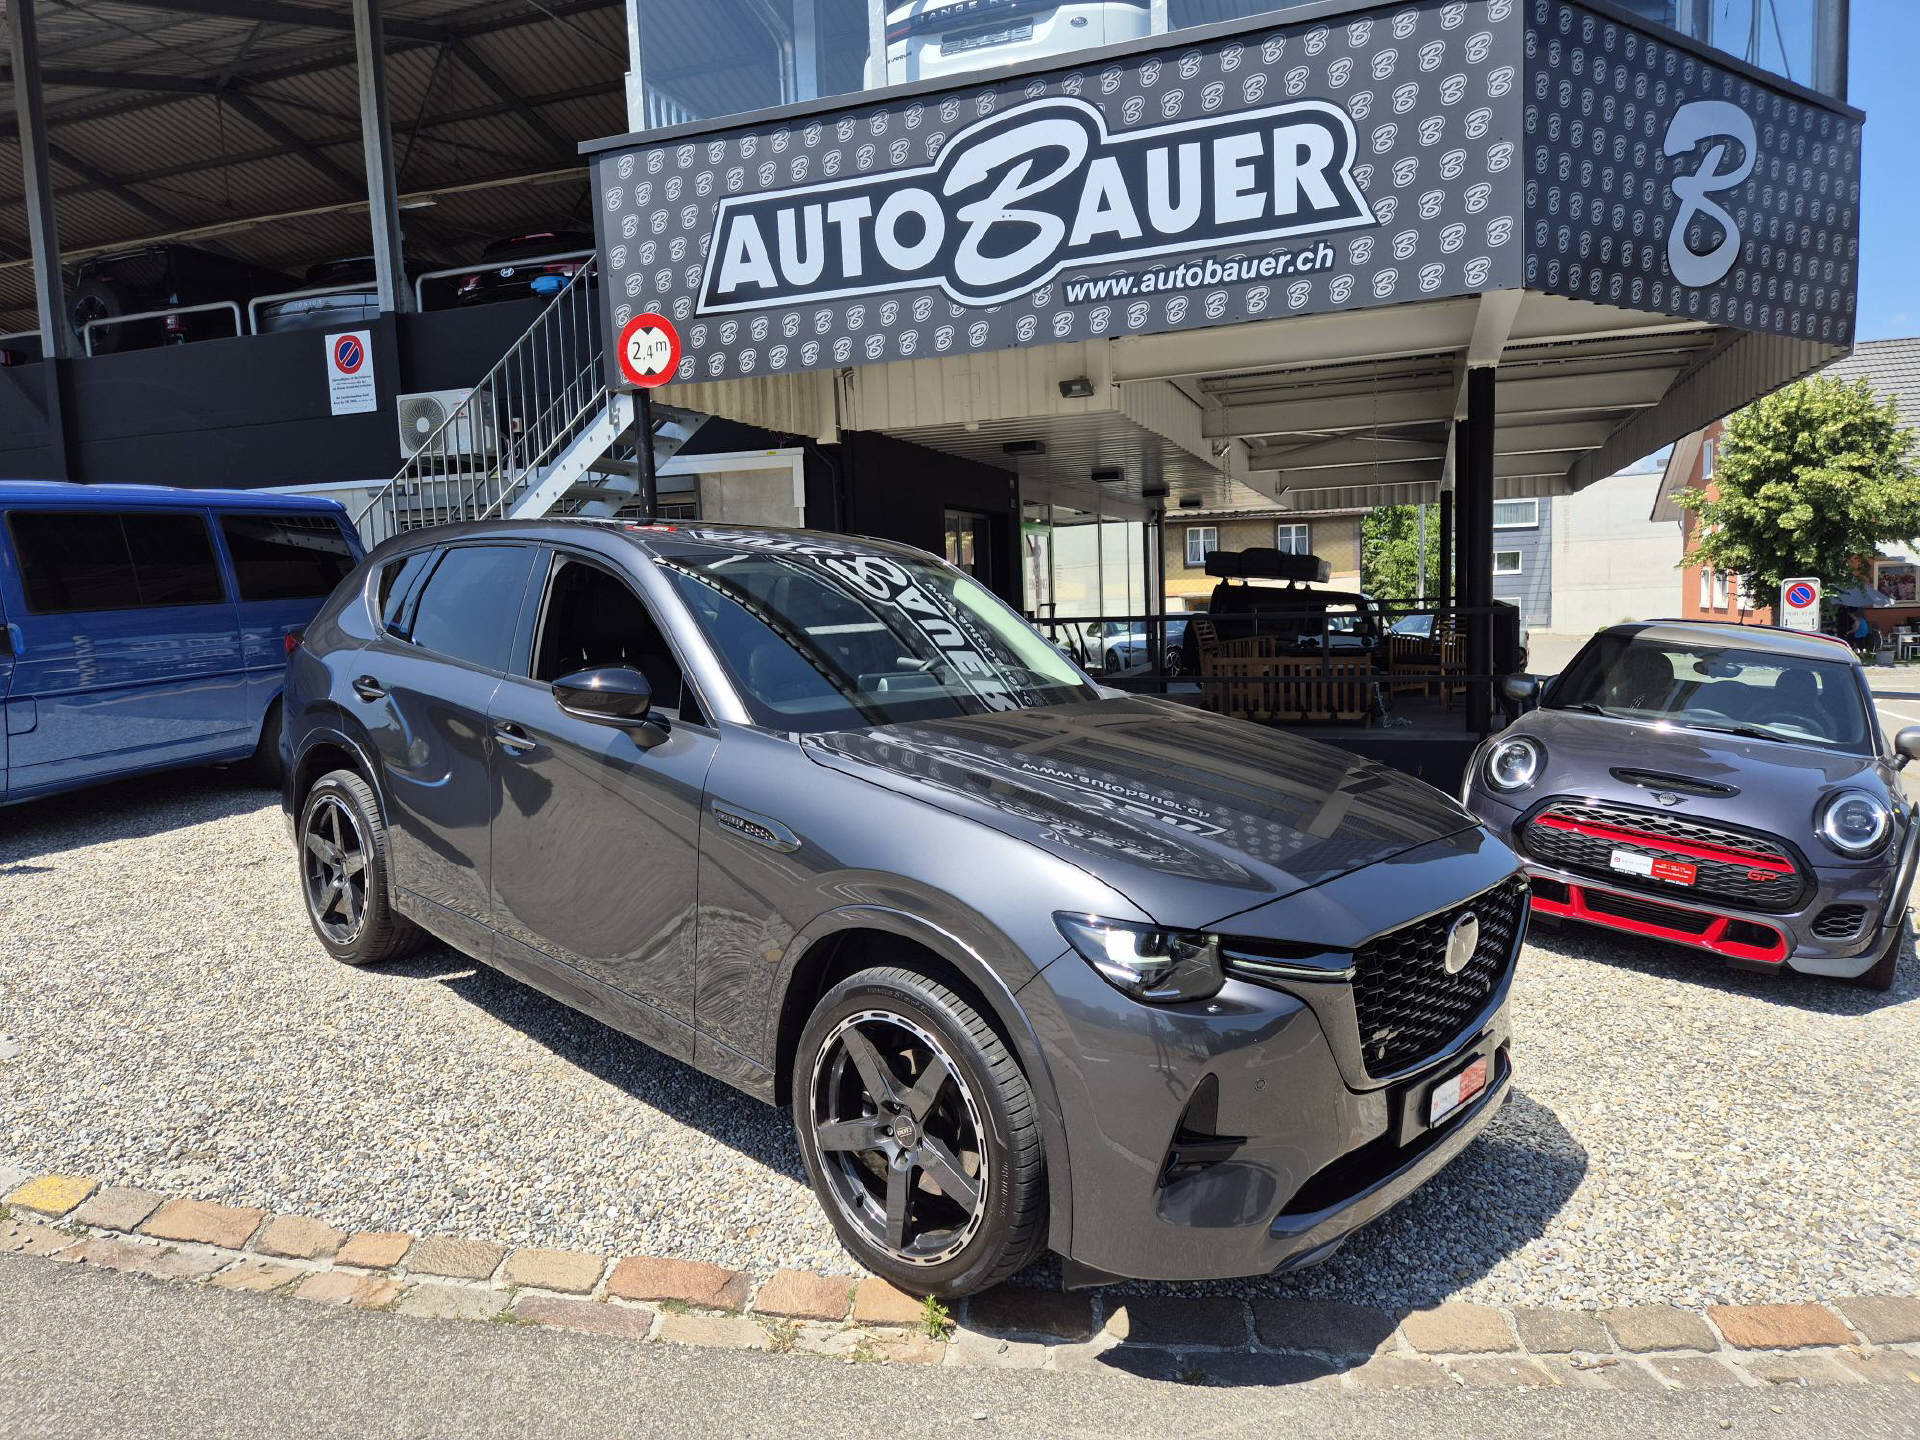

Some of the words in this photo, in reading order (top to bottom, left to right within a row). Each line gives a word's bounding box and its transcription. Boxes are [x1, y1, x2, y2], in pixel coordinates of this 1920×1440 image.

[1664, 100, 1757, 287] B
[1066, 243, 1334, 303] www.autobauer.ch
[1747, 869, 1777, 881] GP
